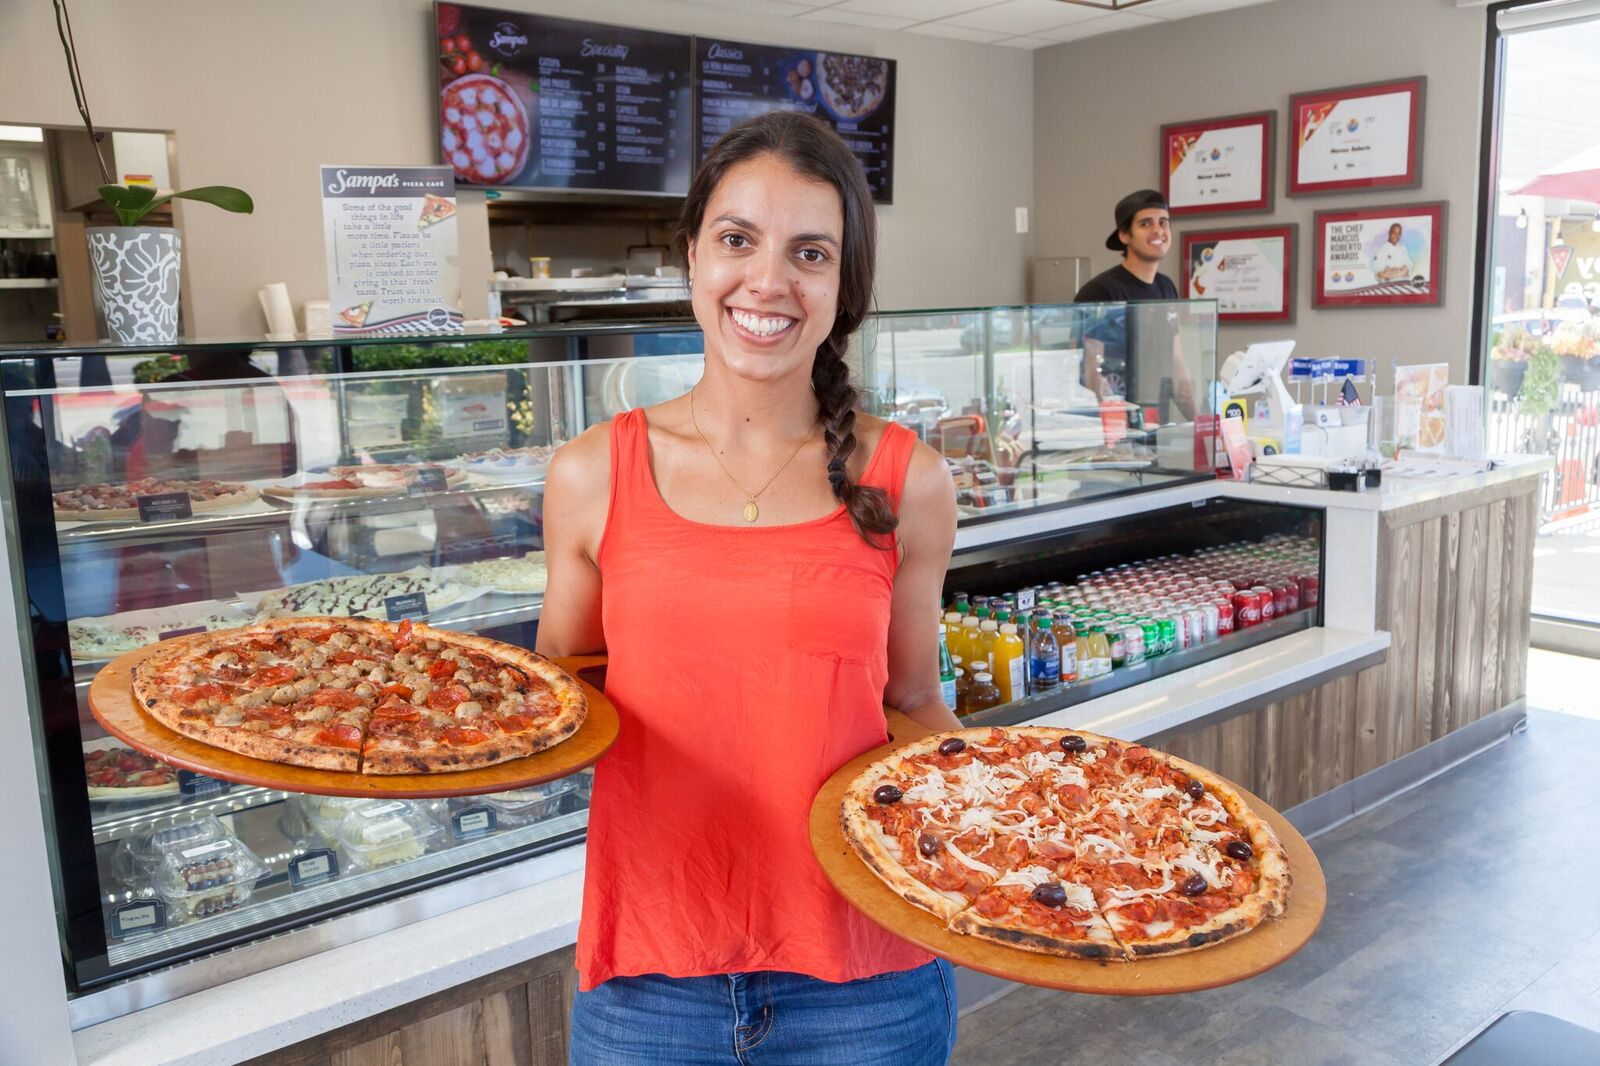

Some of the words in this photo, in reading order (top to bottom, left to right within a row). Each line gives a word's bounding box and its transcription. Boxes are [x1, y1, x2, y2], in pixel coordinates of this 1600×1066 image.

[581, 38, 629, 60] Specialty
[707, 42, 744, 60] Classics
[328, 169, 400, 194] Sampa's
[342, 203, 365, 211] Some
[367, 203, 376, 211] of
[378, 203, 391, 211] the
[393, 203, 413, 214] good
[351, 213, 377, 222] things
[379, 213, 389, 221] in
[390, 213, 404, 221] life
[372, 222, 392, 230] little
[1330, 225, 1343, 234] THE
[1345, 224, 1364, 233] CHEF
[392, 231, 419, 239] Please
[422, 231, 432, 239] be
[1330, 234, 1360, 243] MARCUS
[369, 241, 389, 249] little
[391, 241, 420, 250] patient
[1330, 243, 1362, 252] ROBERTO
[376, 250, 411, 259] ordering
[1330, 252, 1359, 261] AWARDS
[349, 261, 371, 269] pizza
[400, 259, 421, 267] Each
[376, 269, 404, 277] cooked
[353, 280, 379, 289] giving
[380, 287, 404, 295] Trust
[381, 296, 406, 304] worth
[407, 296, 421, 304] the
